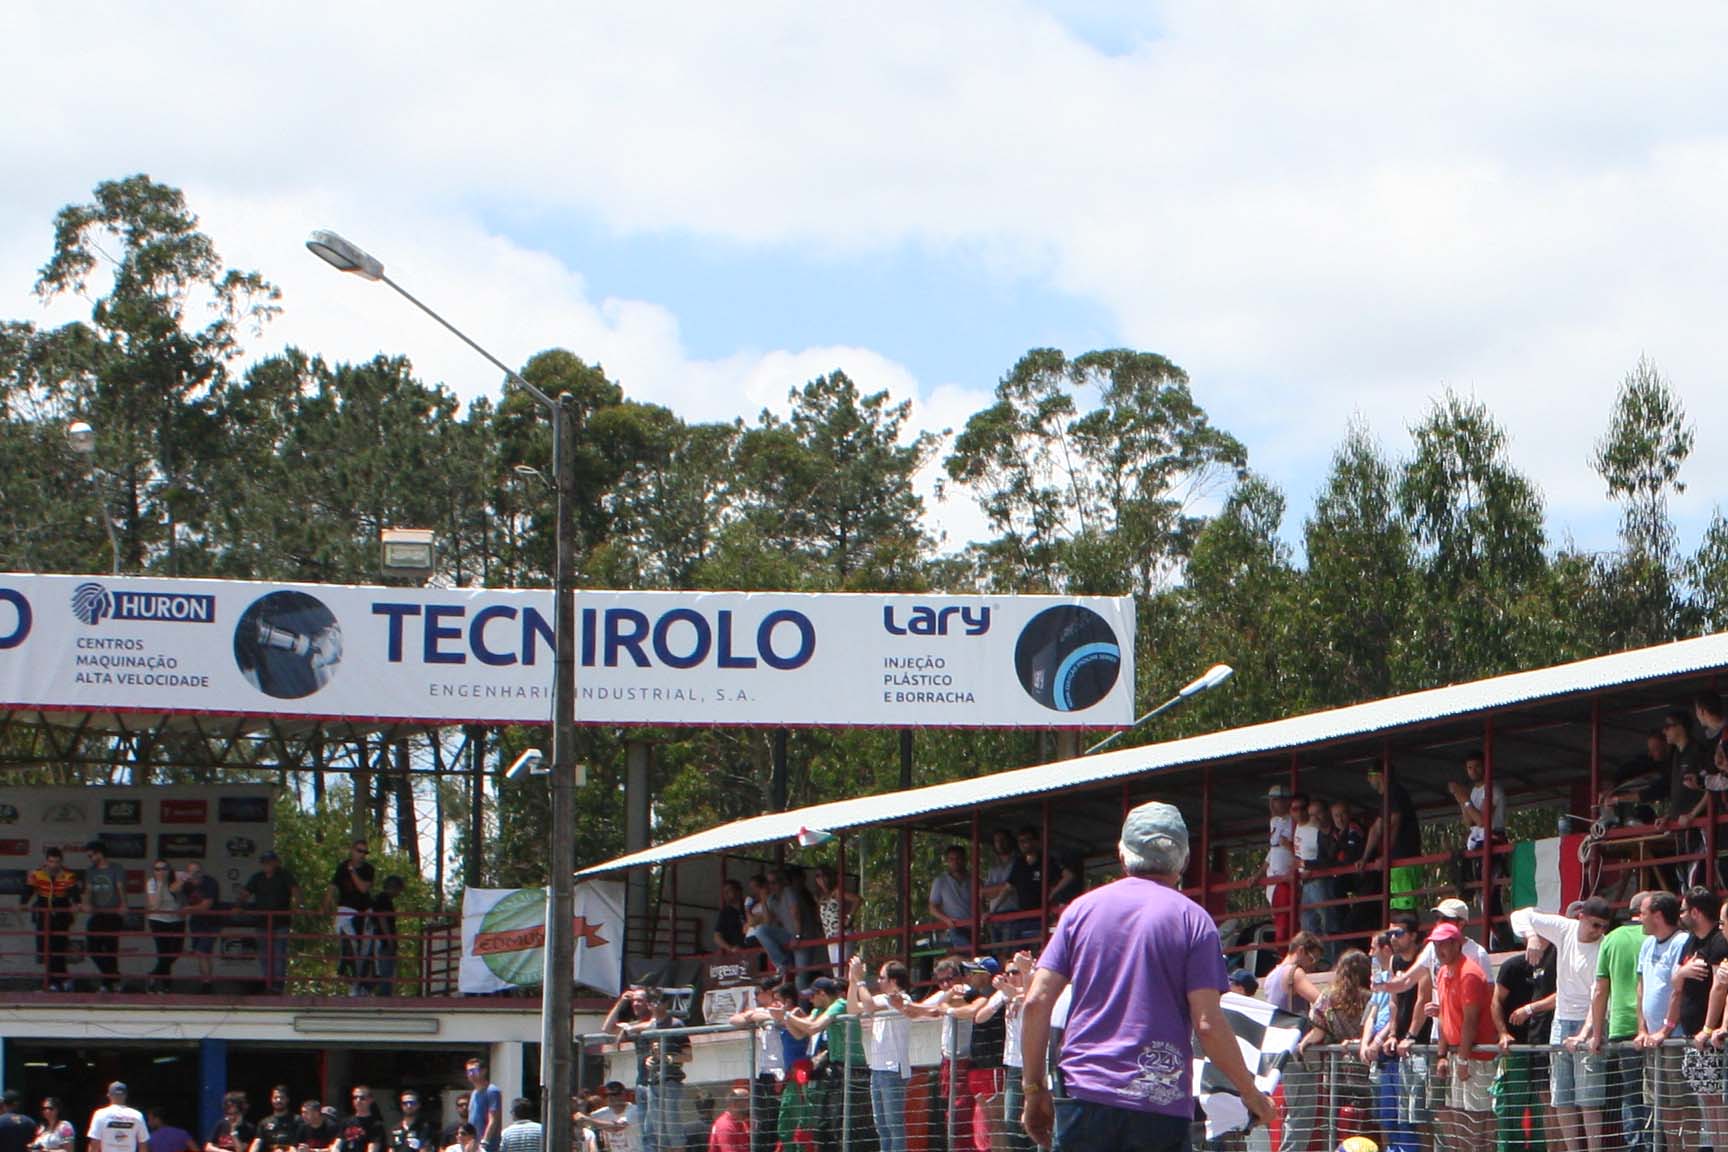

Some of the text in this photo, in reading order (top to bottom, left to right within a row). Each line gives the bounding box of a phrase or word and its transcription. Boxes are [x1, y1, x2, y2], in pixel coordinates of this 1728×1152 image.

[121, 595, 207, 619] HURON
[76, 637, 144, 650] CENTROS
[372, 602, 816, 670] TECNIROLO
[75, 654, 178, 671] MAQUINAÇÃO
[883, 655, 946, 671] INJEÇÃO
[75, 672, 208, 688] ALTA VELOCIDADE
[883, 673, 952, 686] PLÁSTICO
[429, 683, 557, 699] ENGENHARI
[883, 691, 975, 704] E BORRACHA
